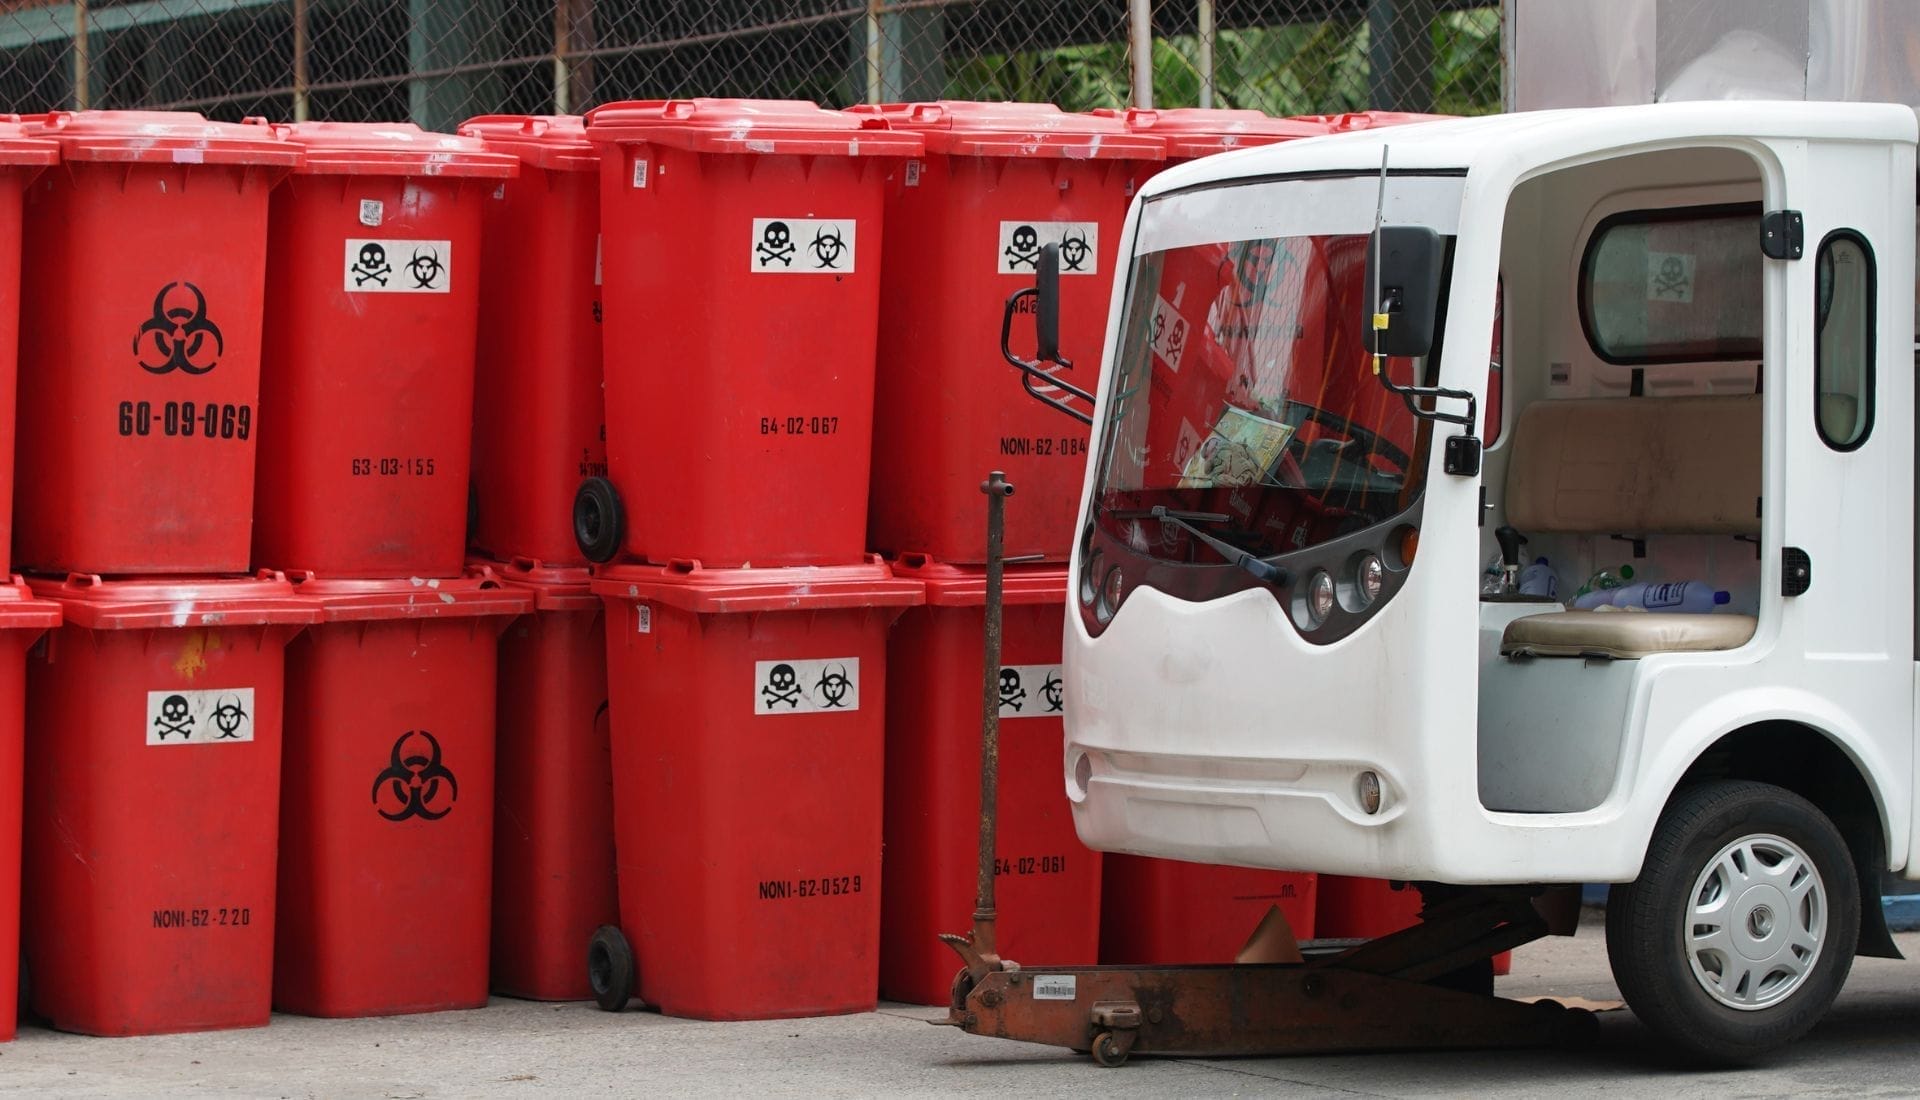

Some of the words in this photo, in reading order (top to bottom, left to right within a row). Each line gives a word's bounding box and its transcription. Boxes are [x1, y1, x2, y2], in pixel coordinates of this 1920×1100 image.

[119, 401, 251, 440] 60-09-069
[761, 417, 838, 434] 64-02-067
[352, 458, 434, 475] 63-03-155
[994, 856, 1065, 875] 64-02-061
